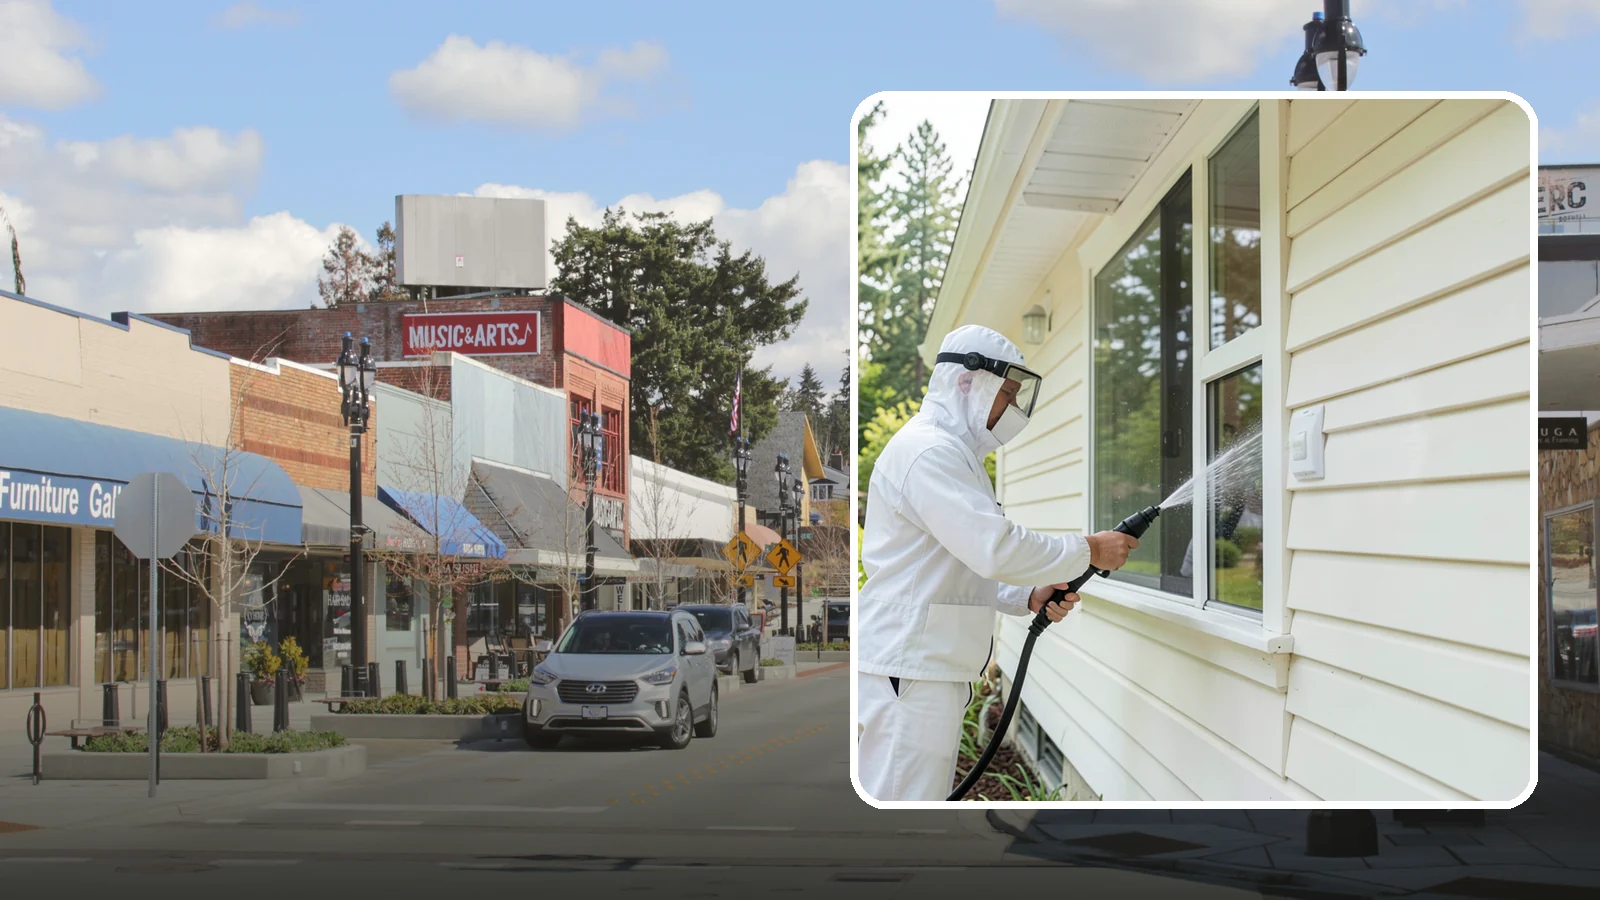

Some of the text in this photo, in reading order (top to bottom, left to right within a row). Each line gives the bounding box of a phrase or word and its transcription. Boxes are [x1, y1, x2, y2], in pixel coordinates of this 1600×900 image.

[409, 323, 520, 349] MUSIC&ARTS
[0, 471, 122, 519] Furniture Gal
